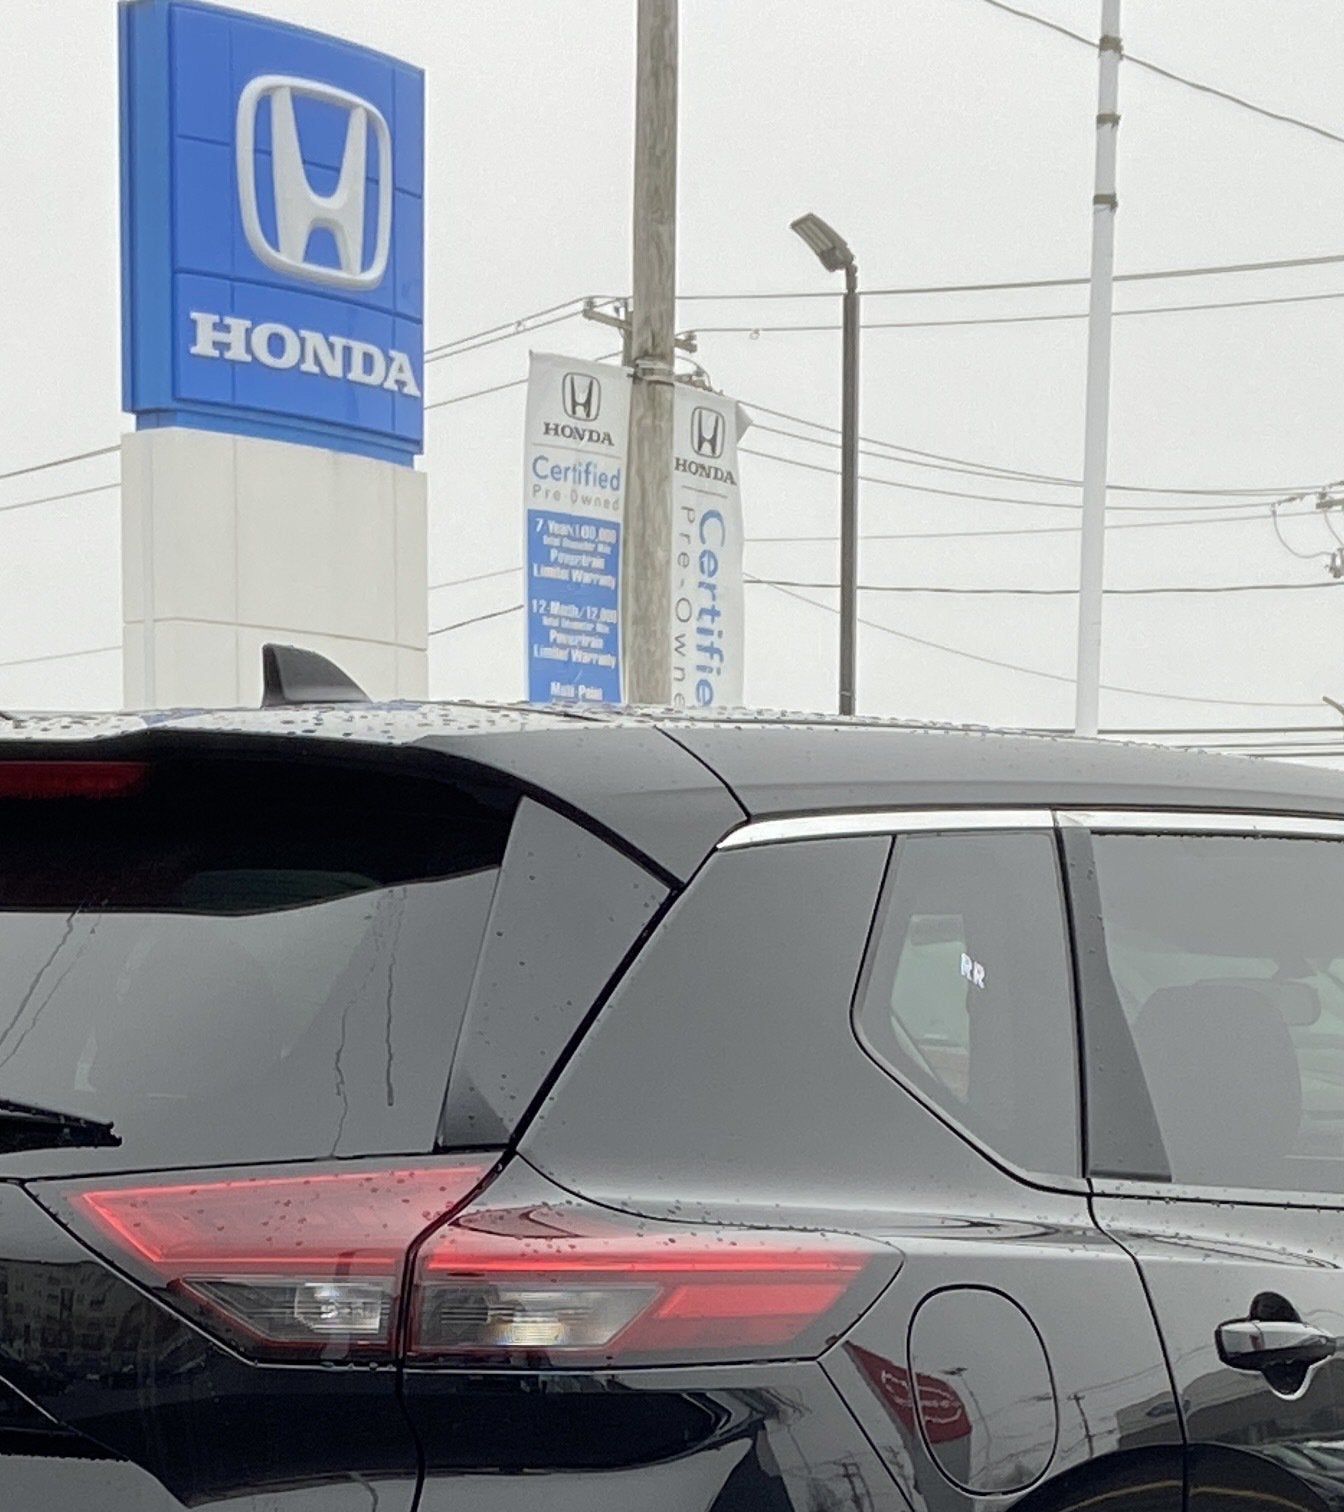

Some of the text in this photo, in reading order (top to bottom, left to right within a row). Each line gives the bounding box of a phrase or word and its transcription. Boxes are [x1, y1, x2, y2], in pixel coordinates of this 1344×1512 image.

[189, 311, 421, 397] HONDA
[543, 421, 615, 447] HONDA
[532, 454, 621, 492] Certified
[674, 457, 738, 486] HONDA
[695, 508, 726, 707] Certifie
